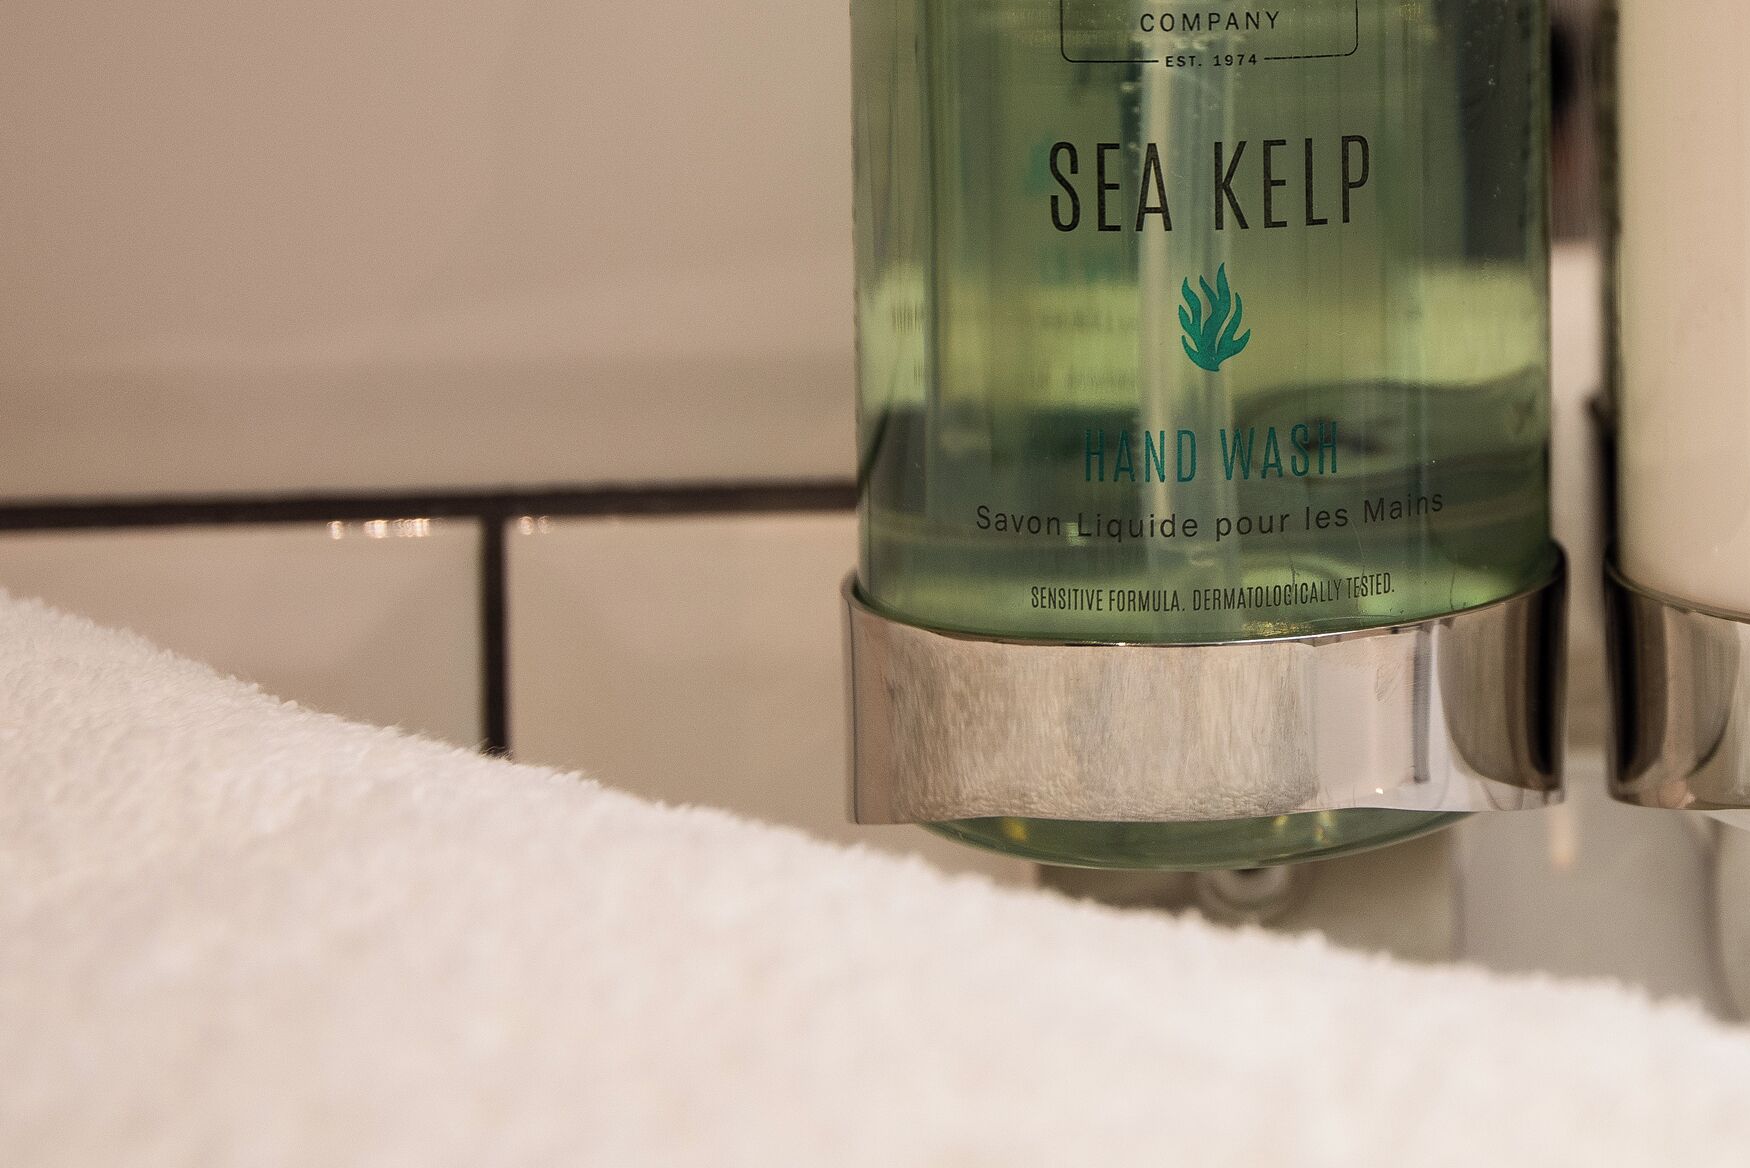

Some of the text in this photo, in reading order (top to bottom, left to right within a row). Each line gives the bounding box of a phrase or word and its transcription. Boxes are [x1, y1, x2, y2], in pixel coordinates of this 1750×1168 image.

[1140, 10, 1280, 33] COMPANY
[1164, 53, 1258, 68] EST. 1974
[1048, 134, 1371, 233] SEA KELP
[1083, 420, 1339, 483] HAND WASH
[975, 492, 1444, 543] Savon Liquide pour les Mains
[1031, 572, 1396, 612] SENSITIVE FORMULA. DERMATOLOGICALLY TESTED.
